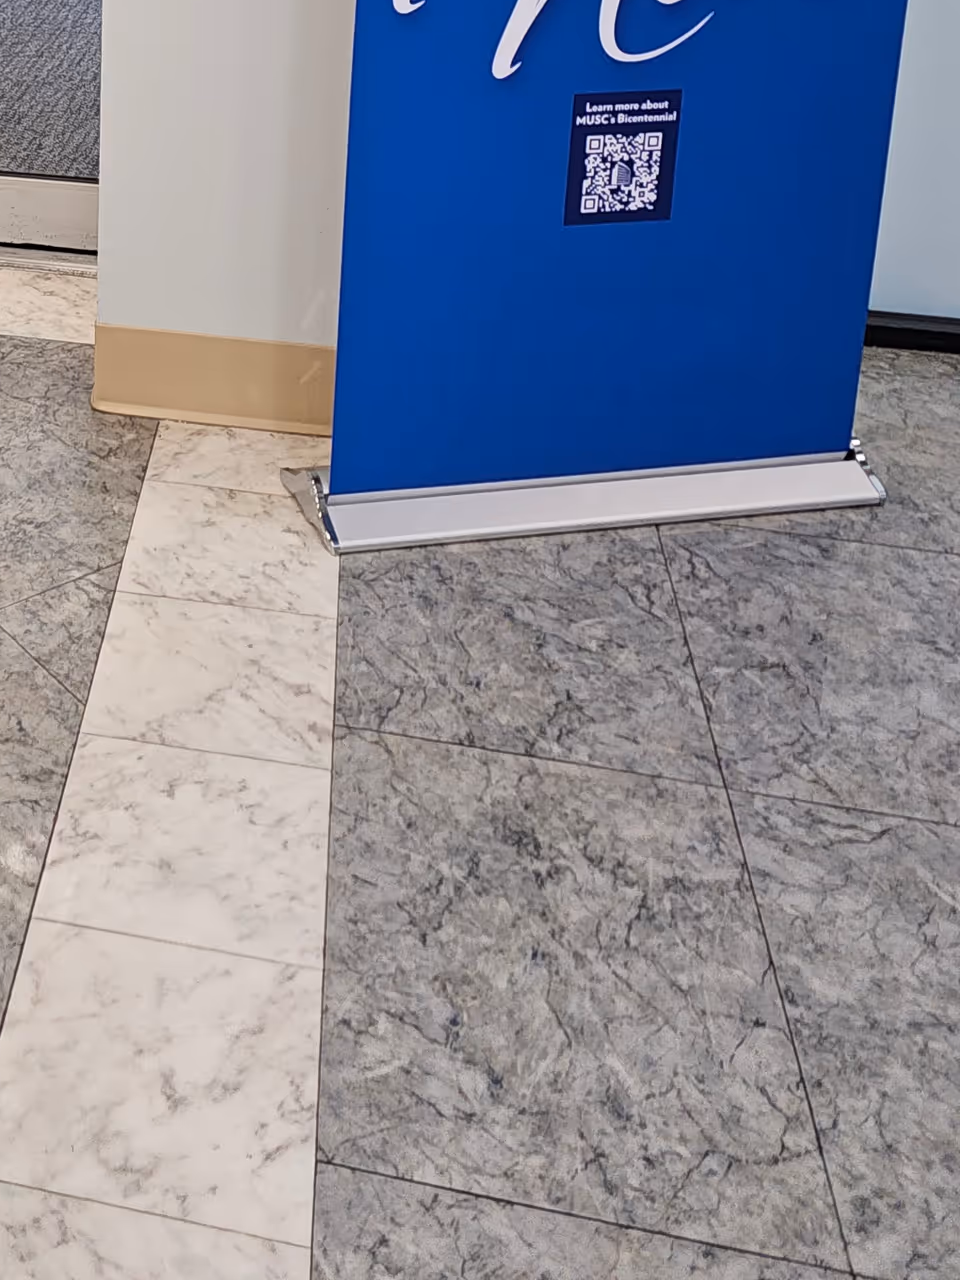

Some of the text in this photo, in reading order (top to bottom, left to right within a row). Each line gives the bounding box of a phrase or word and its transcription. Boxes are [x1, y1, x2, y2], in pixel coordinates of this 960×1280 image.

[585, 99, 669, 113] Learn more about
[576, 110, 677, 126] MUSC's Bicentennial
